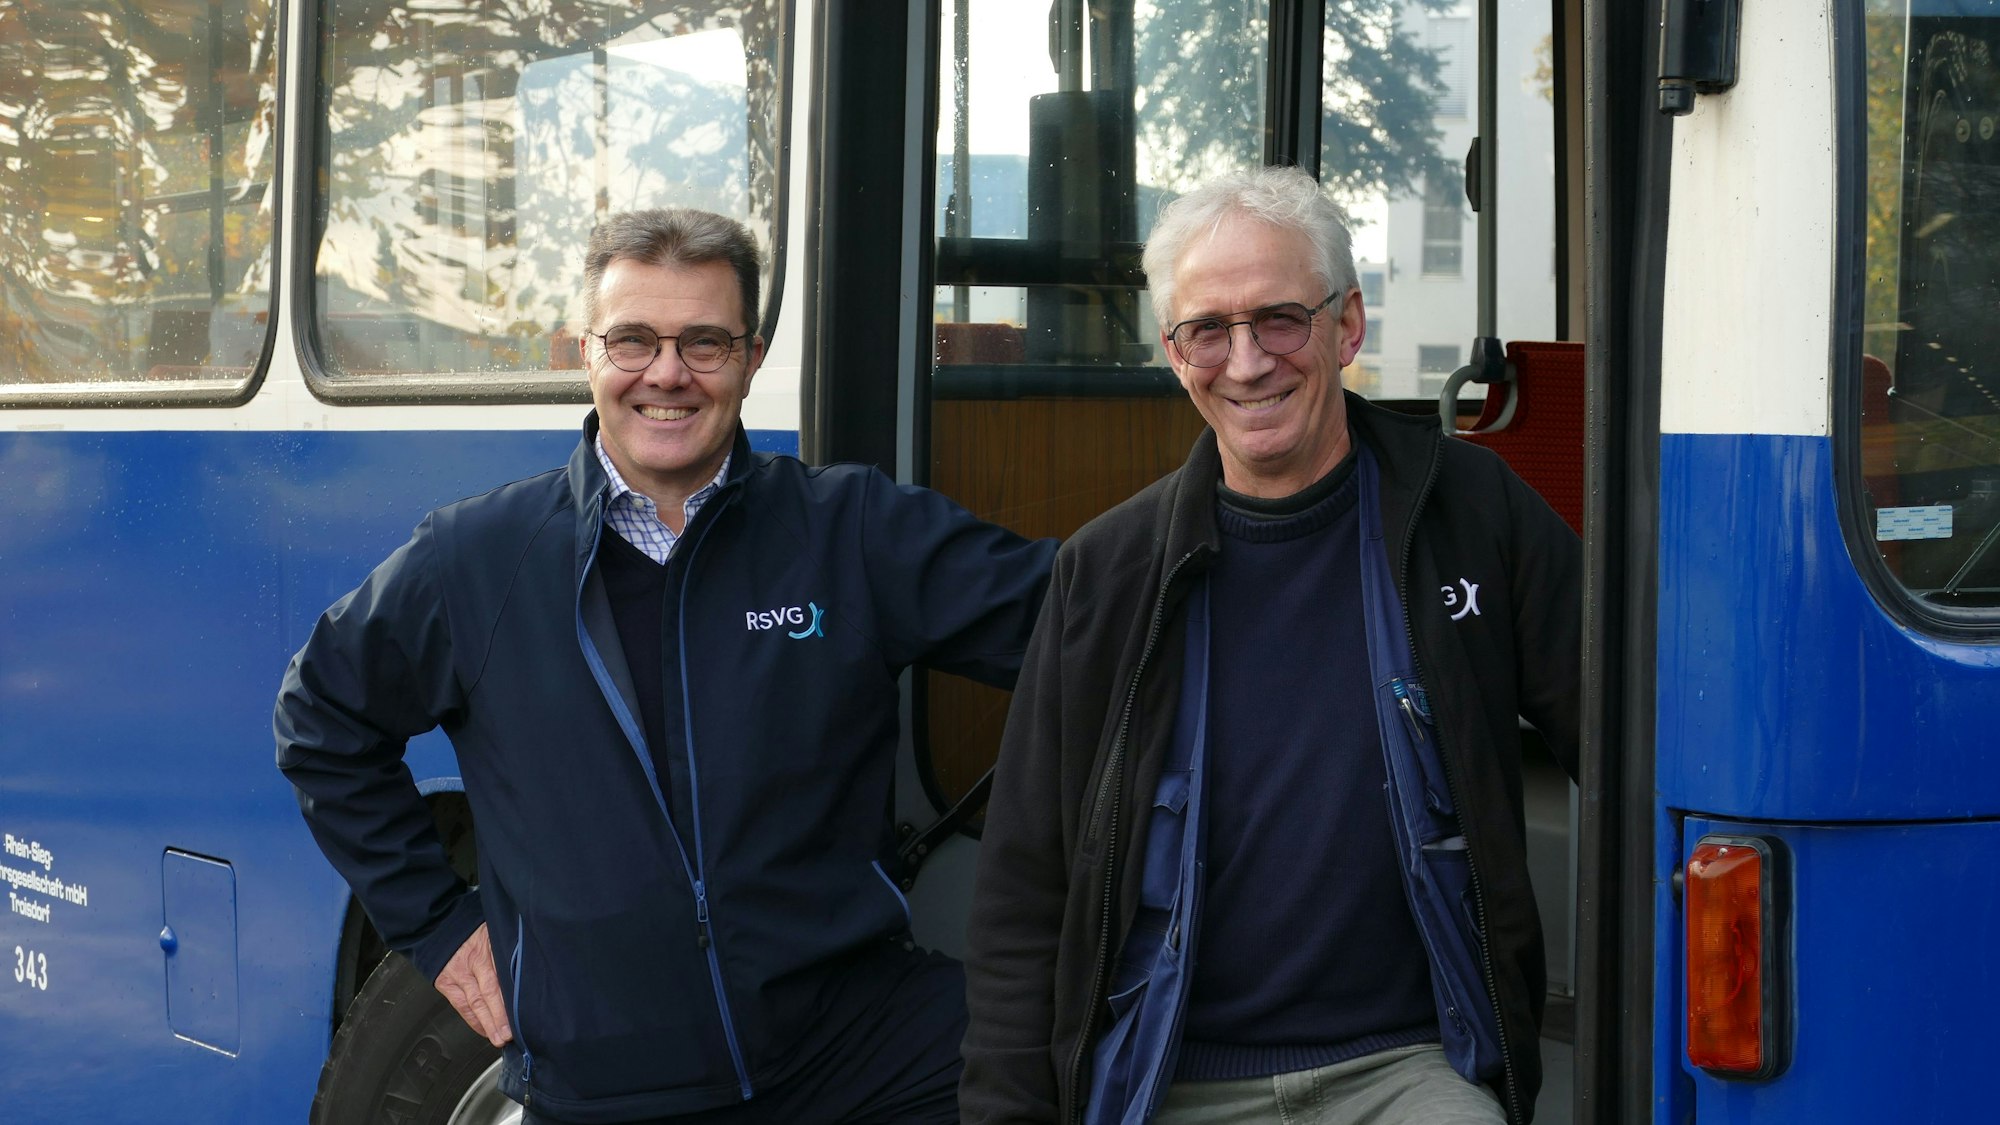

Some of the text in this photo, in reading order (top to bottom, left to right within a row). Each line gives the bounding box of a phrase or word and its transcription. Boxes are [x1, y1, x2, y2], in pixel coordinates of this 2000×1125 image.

[746, 606, 804, 630] RSVG
[5, 834, 54, 871] Rhein-Sieg-
[9, 892, 51, 924] Troisdorf
[65, 886, 88, 907] mbH
[14, 945, 48, 991] 343
